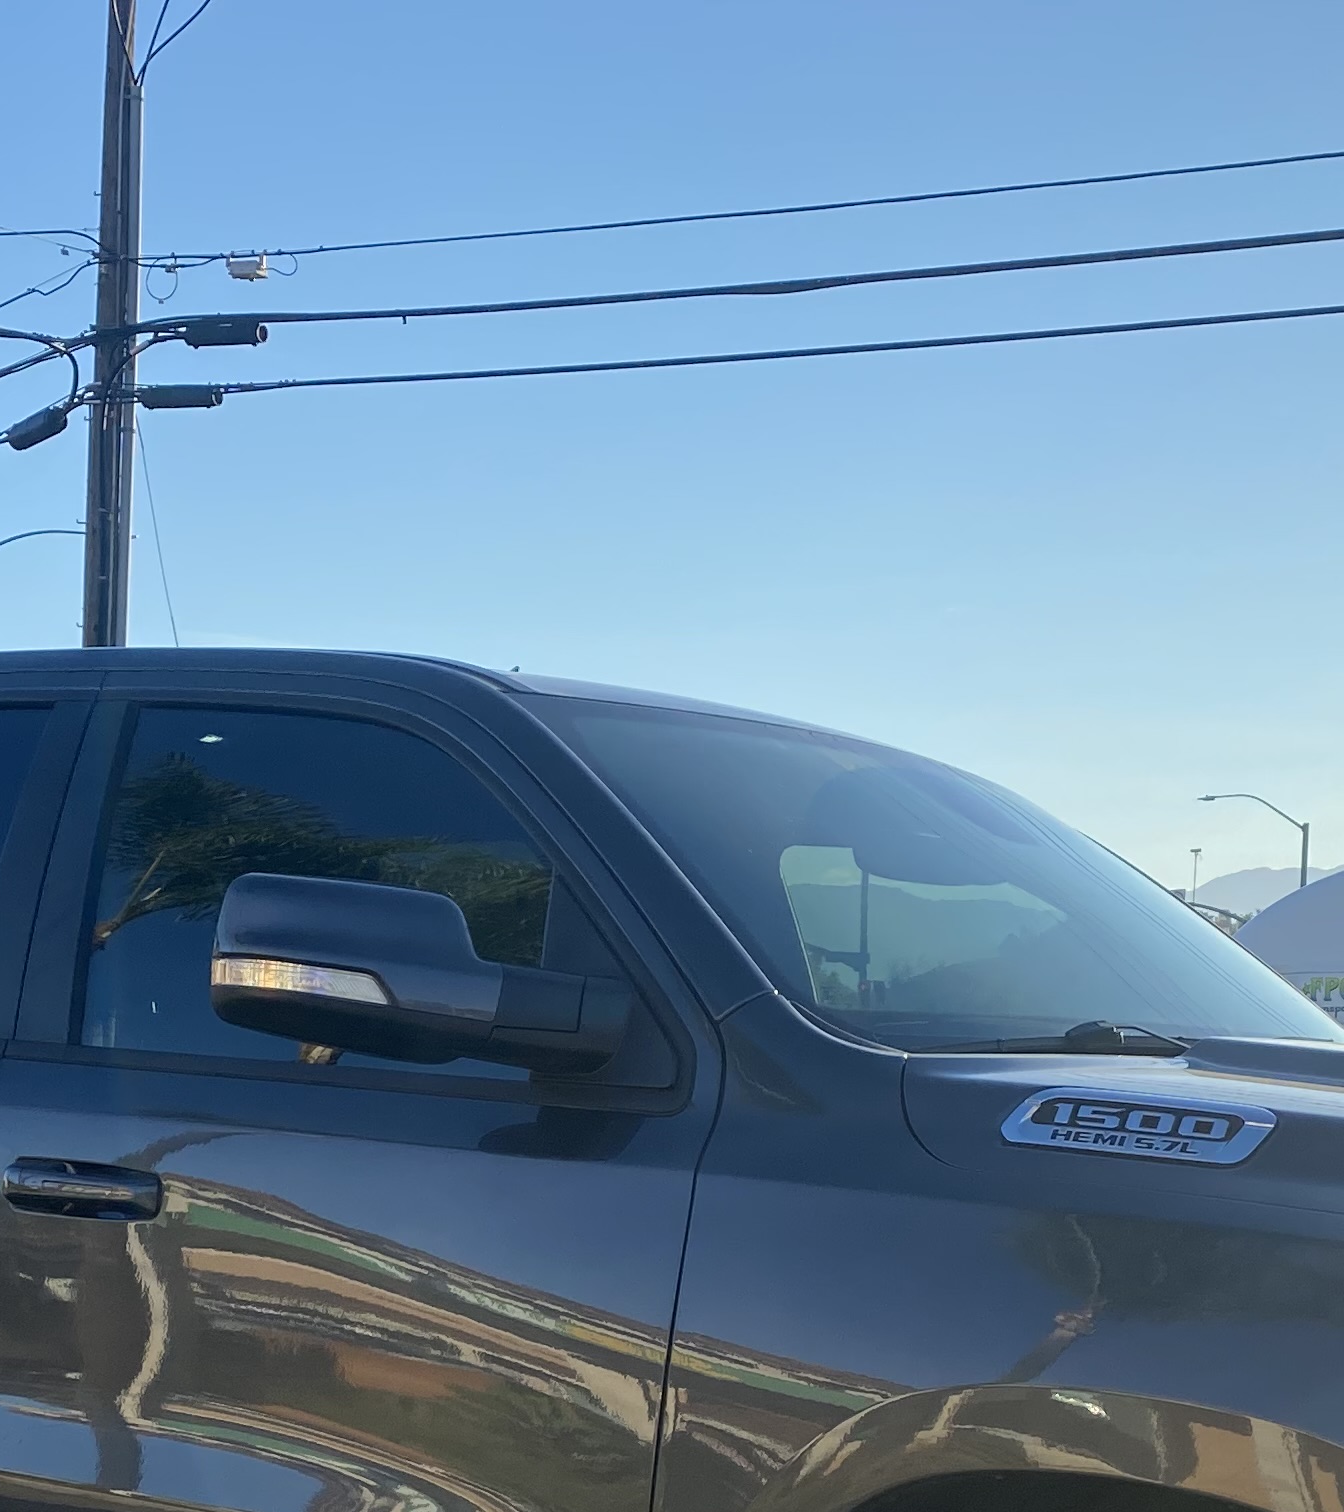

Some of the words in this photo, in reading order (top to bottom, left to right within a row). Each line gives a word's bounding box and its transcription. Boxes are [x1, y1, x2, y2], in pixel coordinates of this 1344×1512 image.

[1053, 1102, 1230, 1139] 1500
[1050, 1128, 1127, 1147] HEMI
[1133, 1136, 1199, 1155] 5.7L
